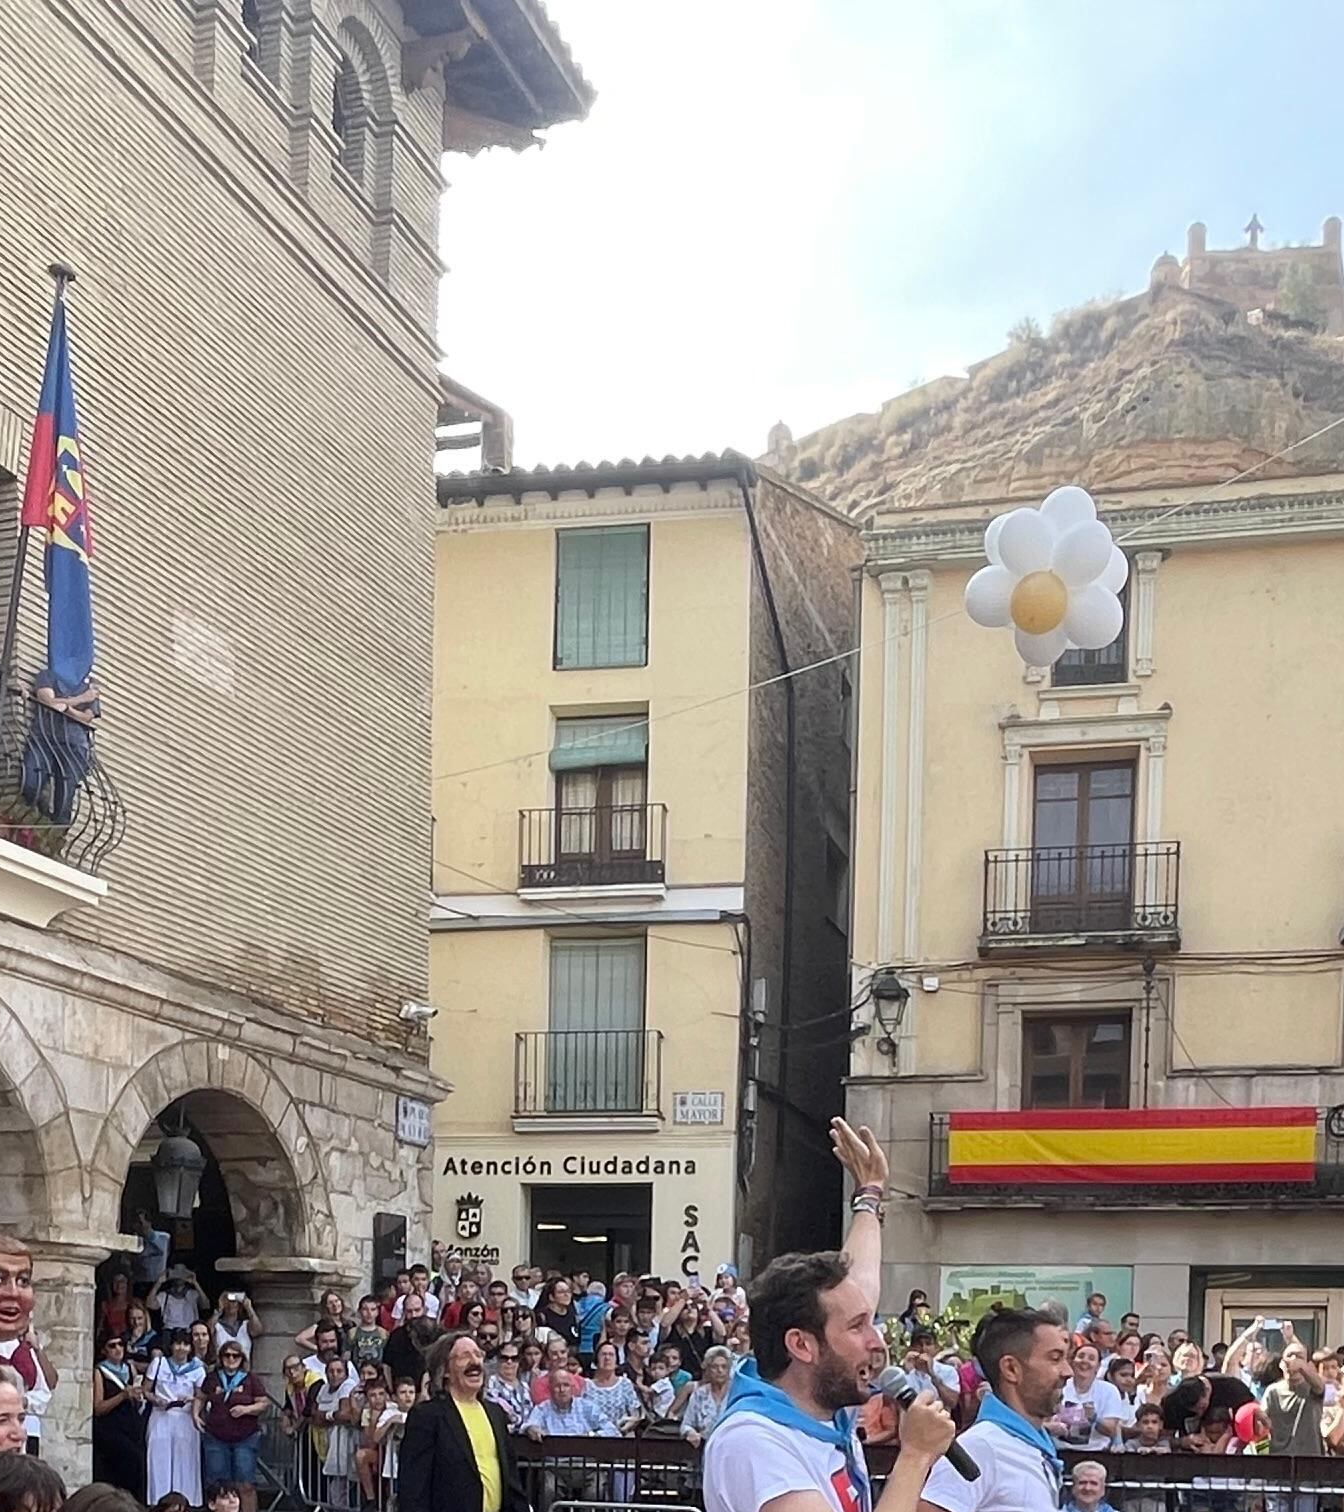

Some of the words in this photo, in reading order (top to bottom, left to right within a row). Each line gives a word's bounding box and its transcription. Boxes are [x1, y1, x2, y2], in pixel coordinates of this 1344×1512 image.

[679, 1109, 718, 1120] MAYOR
[442, 1156, 552, 1176] Atención
[563, 1156, 697, 1176] Ciudadana
